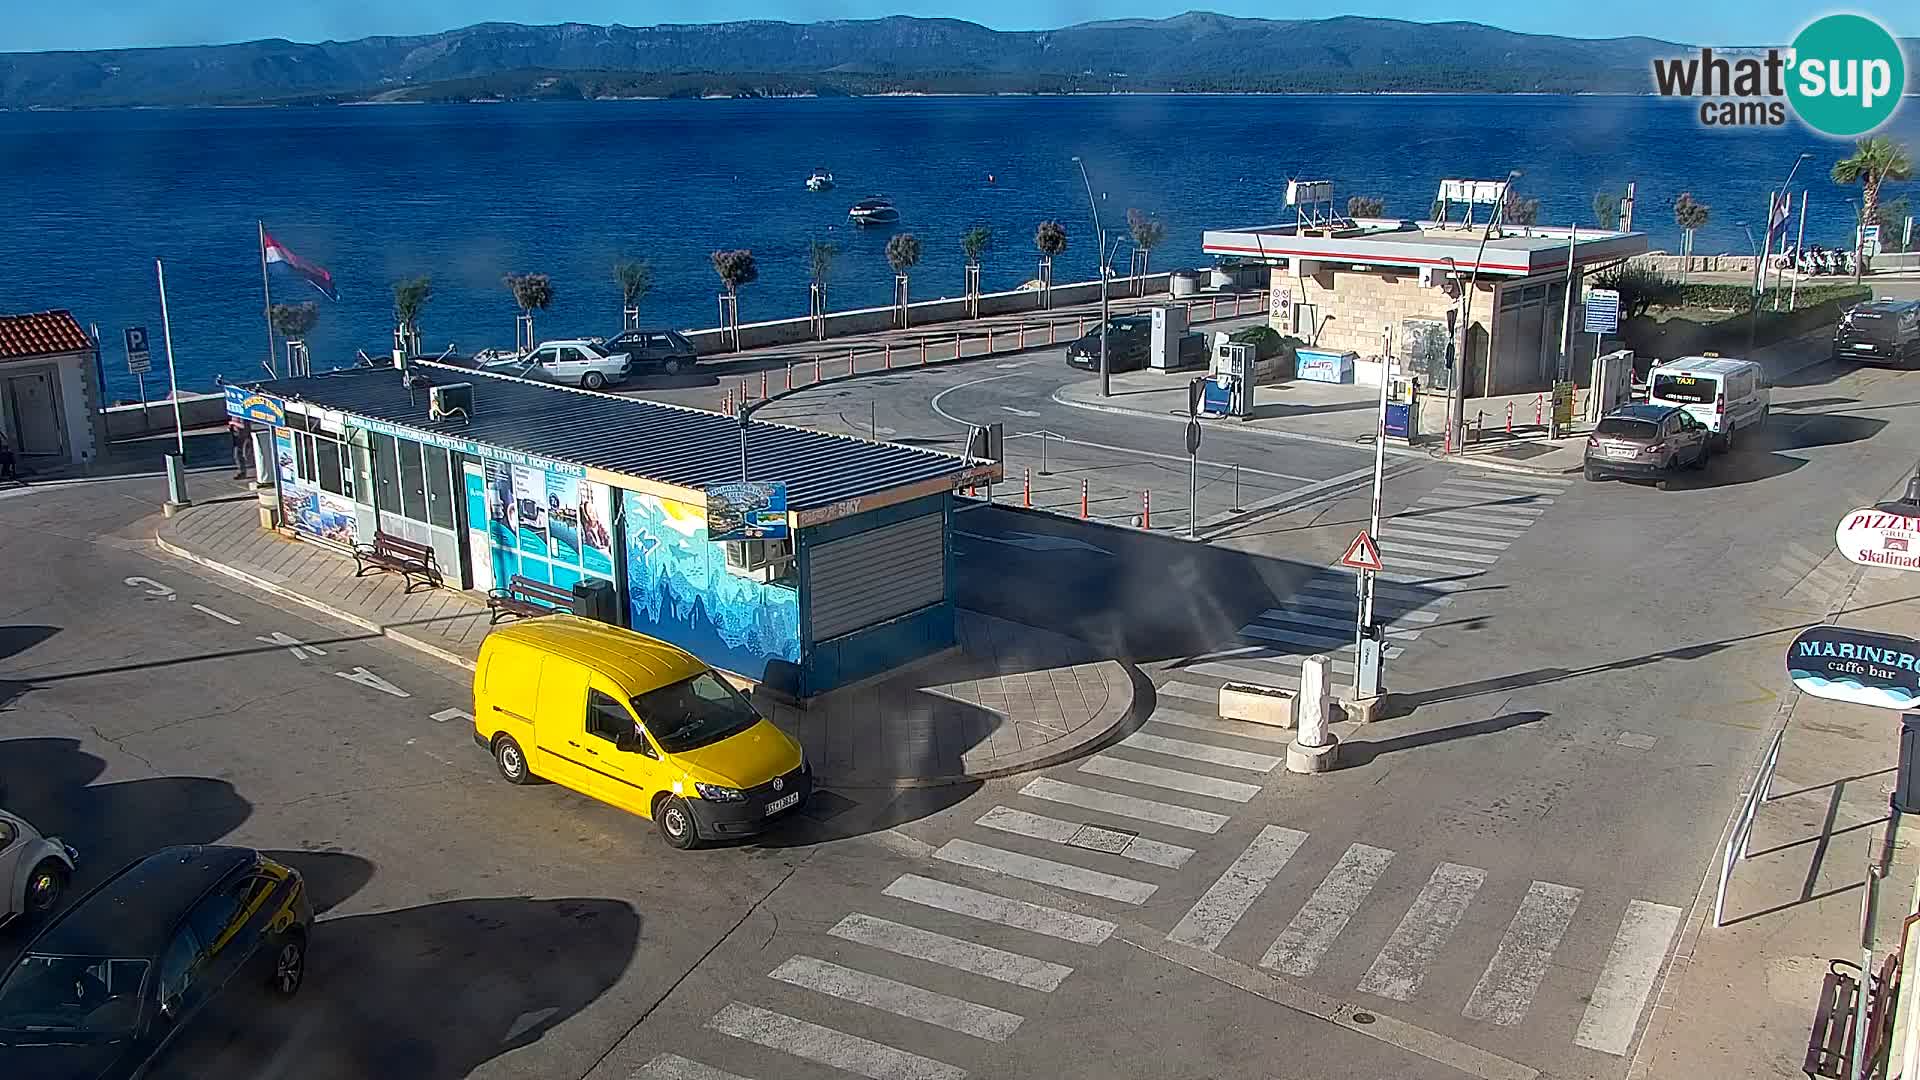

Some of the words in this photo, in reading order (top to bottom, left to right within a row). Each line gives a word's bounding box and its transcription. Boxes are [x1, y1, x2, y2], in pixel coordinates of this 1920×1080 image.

[130, 331, 142, 349] P
[1676, 377, 1695, 385] TAXI
[436, 437, 467, 452] POSTAJA
[477, 445, 493, 457] BUS
[494, 449, 526, 464] STATION
[528, 455, 554, 470] TICKET
[555, 463, 582, 477] OFFICE
[1880, 530, 1916, 540] GRILL
[1828, 661, 1864, 675] caffe
[1869, 665, 1896, 680] bar
